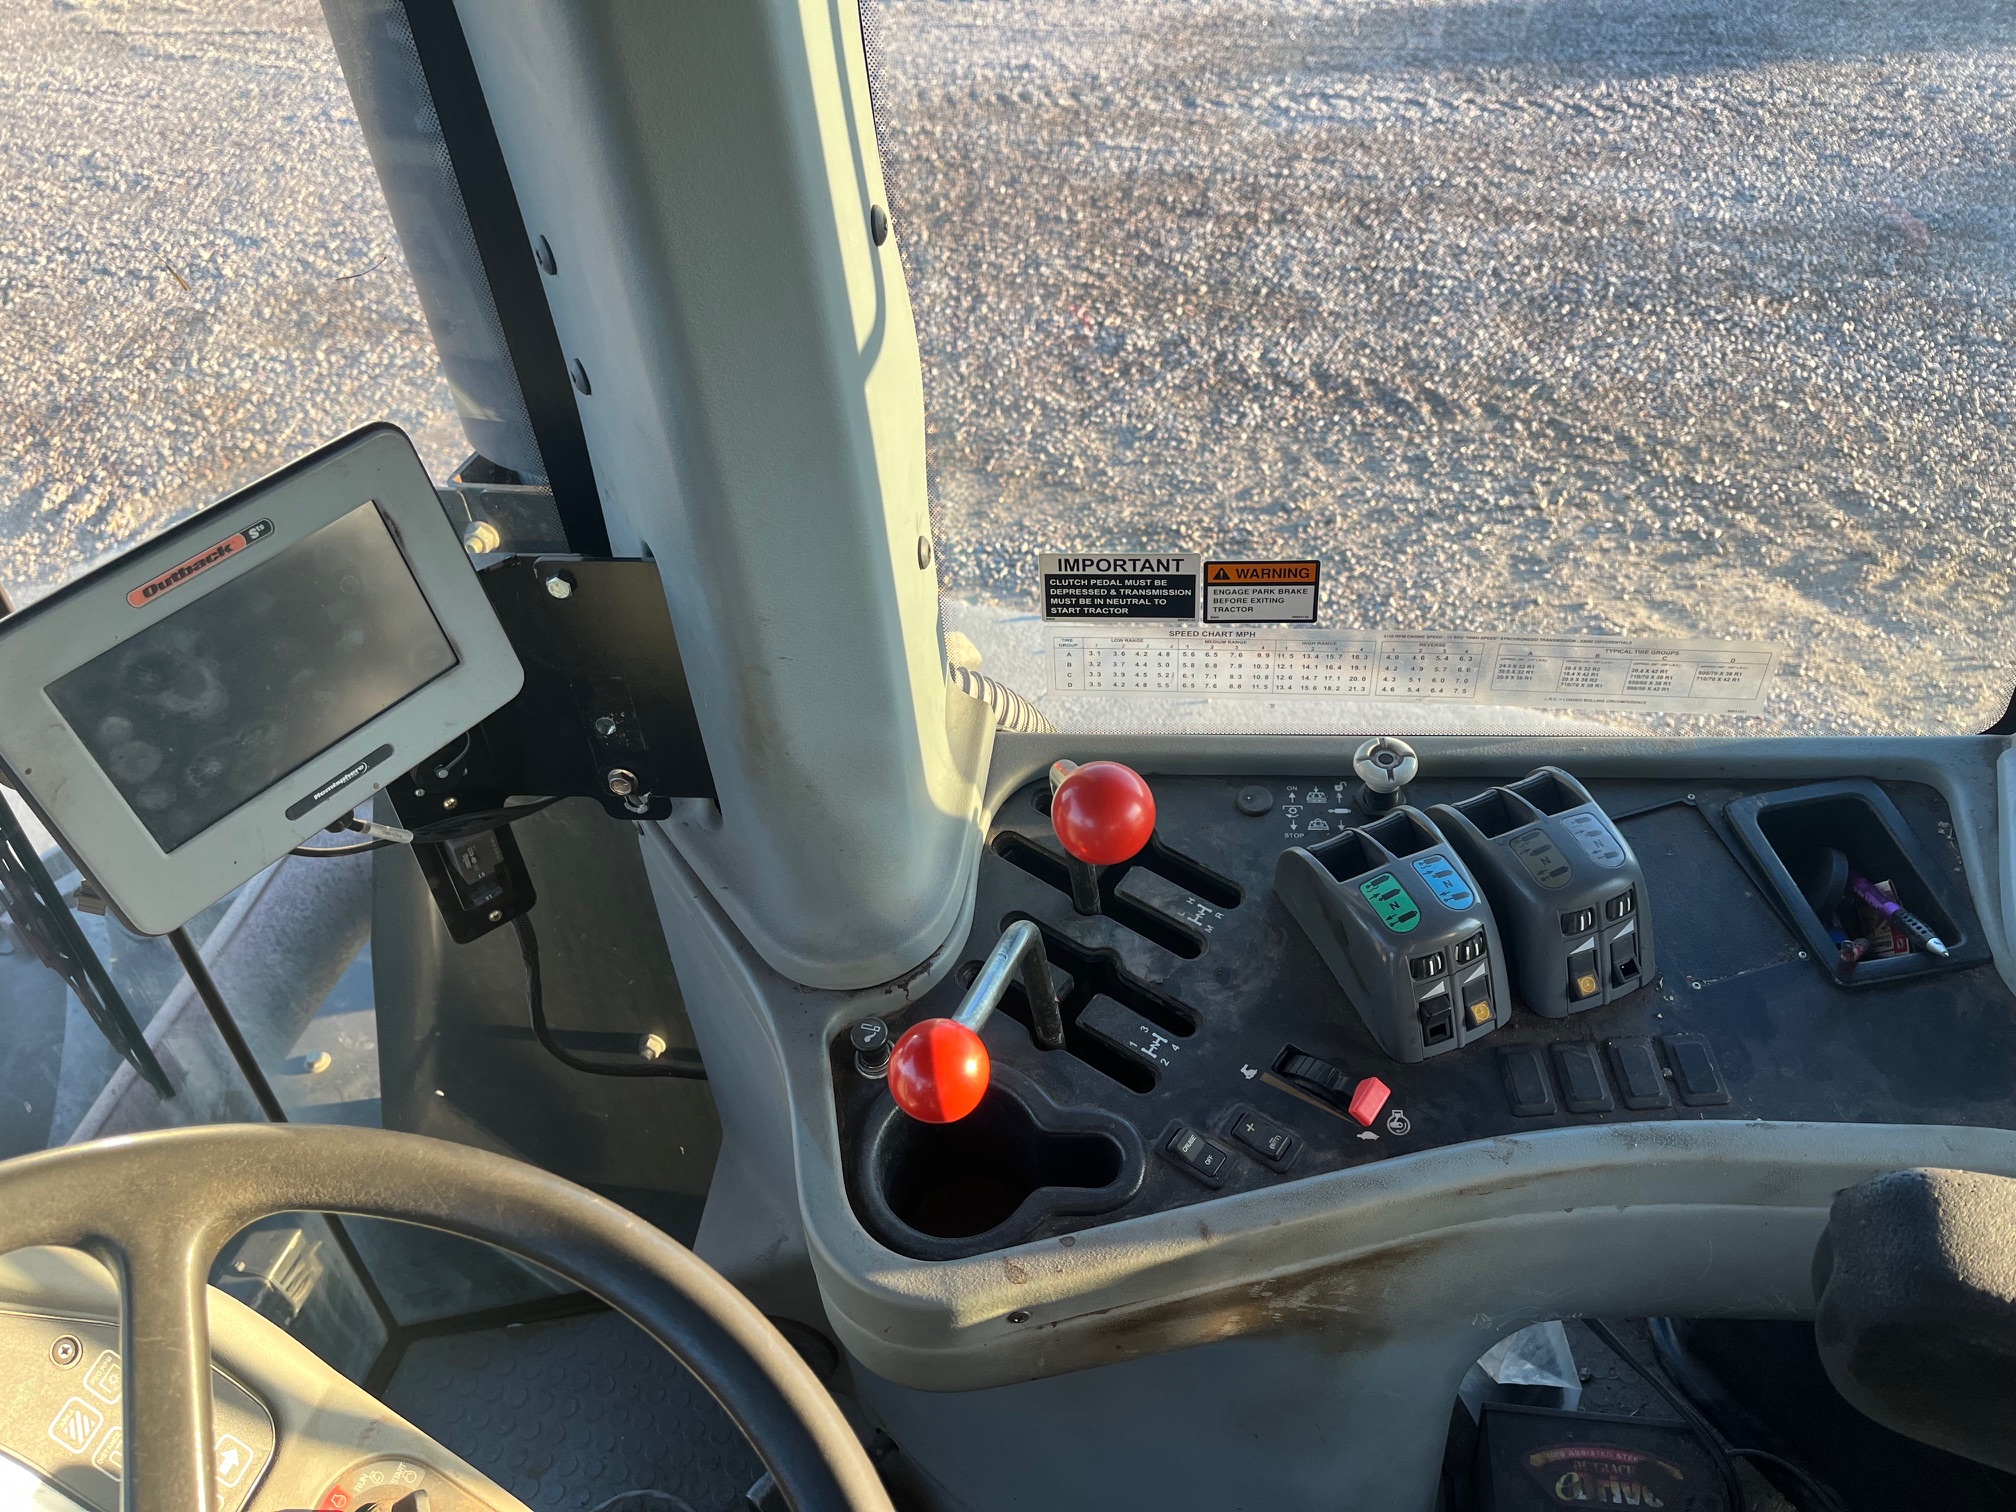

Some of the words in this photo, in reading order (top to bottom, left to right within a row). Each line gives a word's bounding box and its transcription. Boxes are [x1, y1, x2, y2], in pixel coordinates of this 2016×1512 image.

[142, 542, 233, 598] Outback
[1058, 558, 1184, 572] IMPORTANT
[1236, 568, 1310, 579] WARNING
[1443, 880, 1453, 888] N
[1390, 901, 1400, 910] N
[1204, 925, 1215, 934] M
[1204, 1154, 1214, 1166] OFF
[391, 1462, 406, 1484] START
[354, 1474, 369, 1492] RUN
